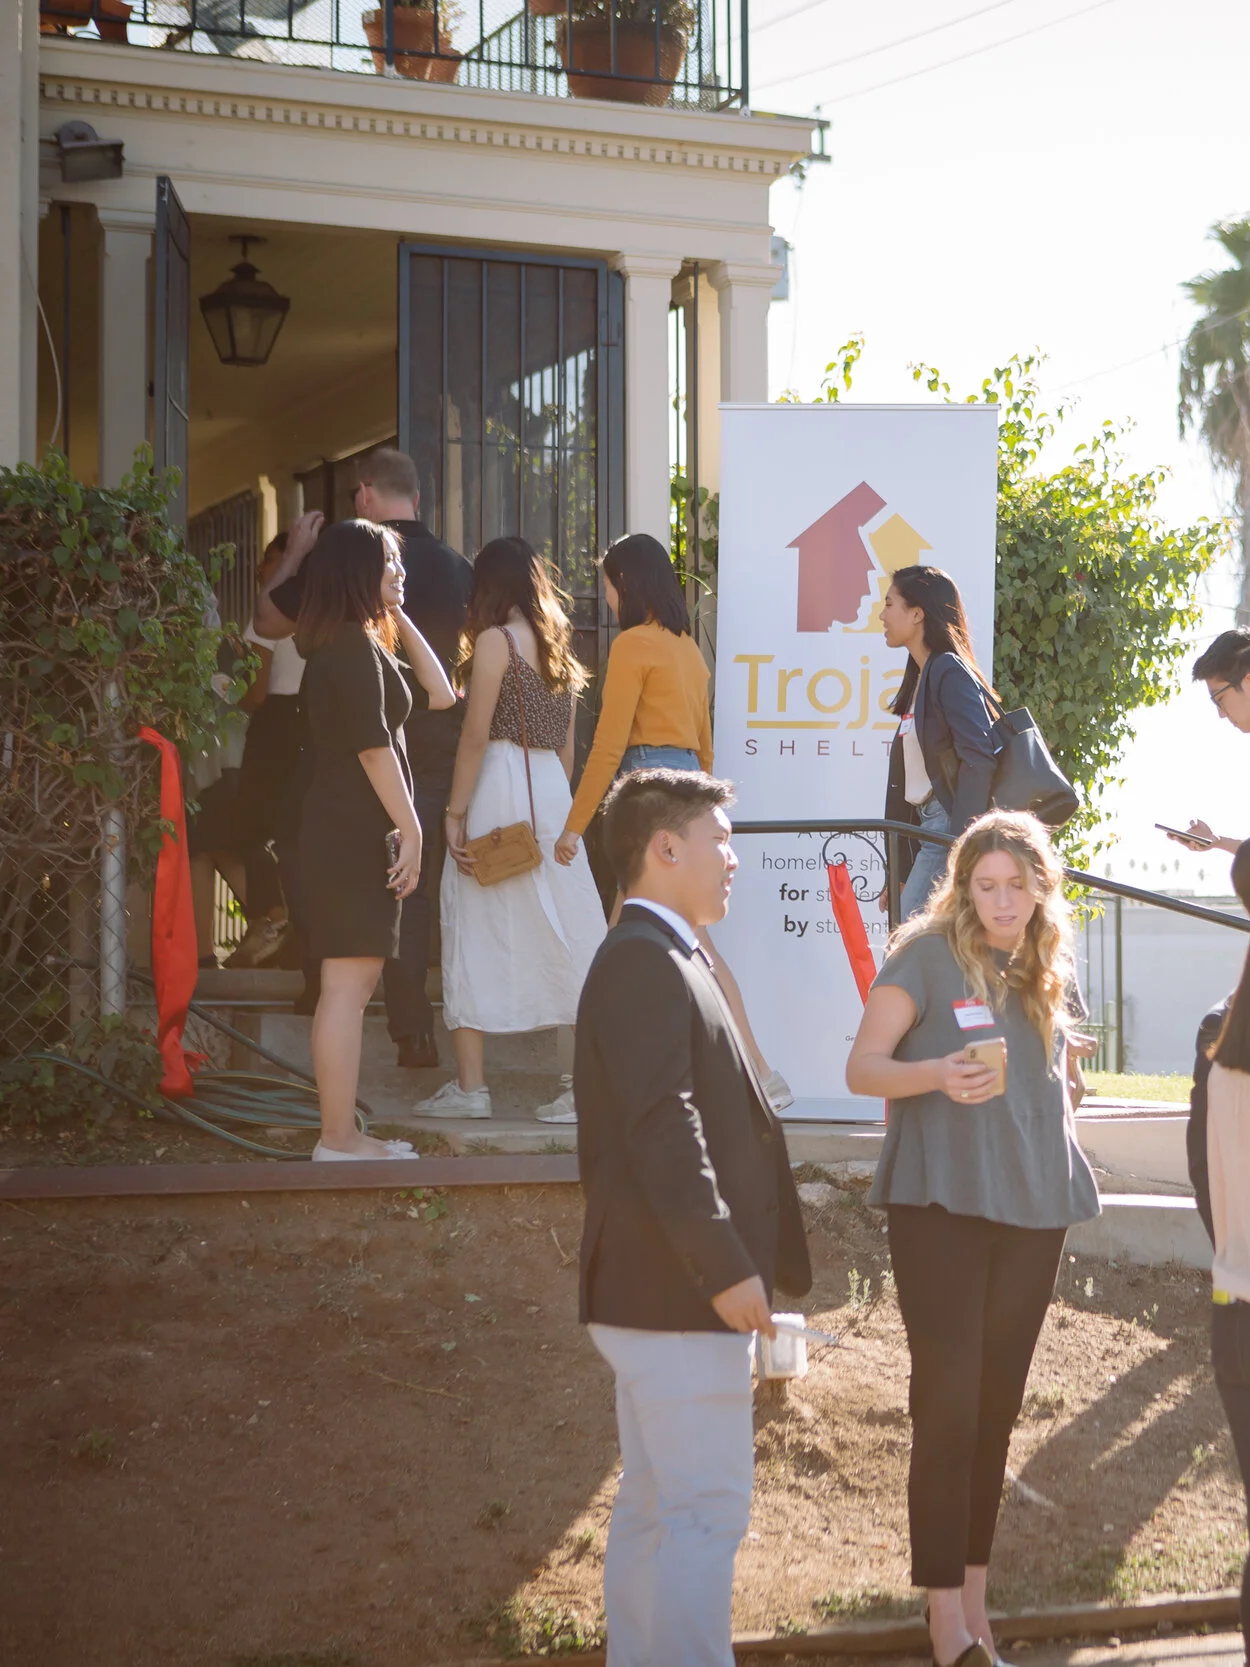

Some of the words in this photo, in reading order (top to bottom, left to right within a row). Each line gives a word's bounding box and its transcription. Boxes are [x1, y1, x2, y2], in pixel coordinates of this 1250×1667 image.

[745, 739, 893, 756] SHELT
[779, 883, 809, 901] for
[784, 914, 809, 938] by
[816, 918, 889, 934] stuent
